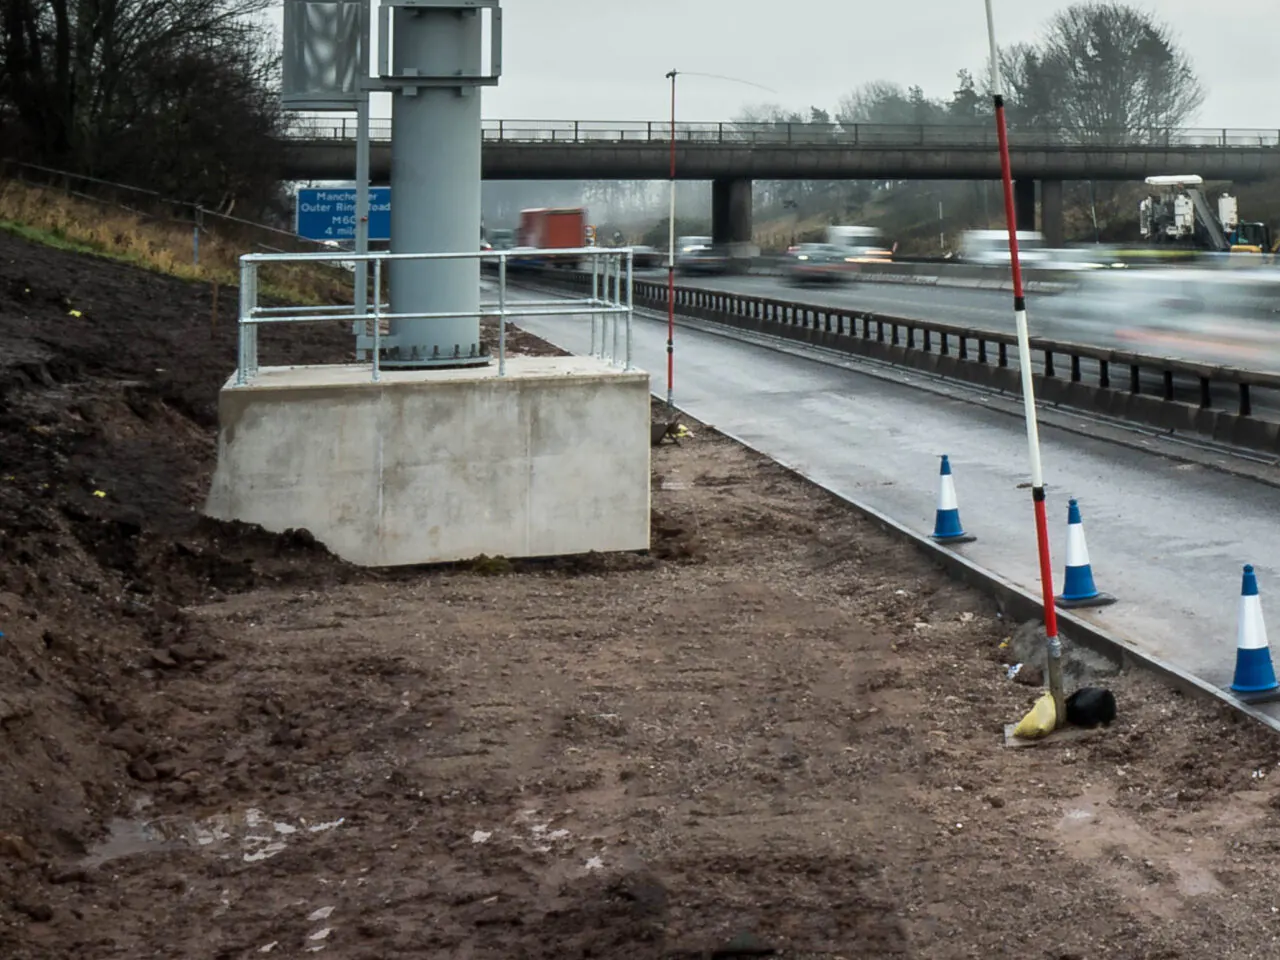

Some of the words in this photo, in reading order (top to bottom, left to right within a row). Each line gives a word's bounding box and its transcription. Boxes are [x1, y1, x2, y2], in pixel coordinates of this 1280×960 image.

[317, 192, 378, 201] Mancheer
[301, 203, 331, 212] Outer
[325, 227, 333, 235] 4
